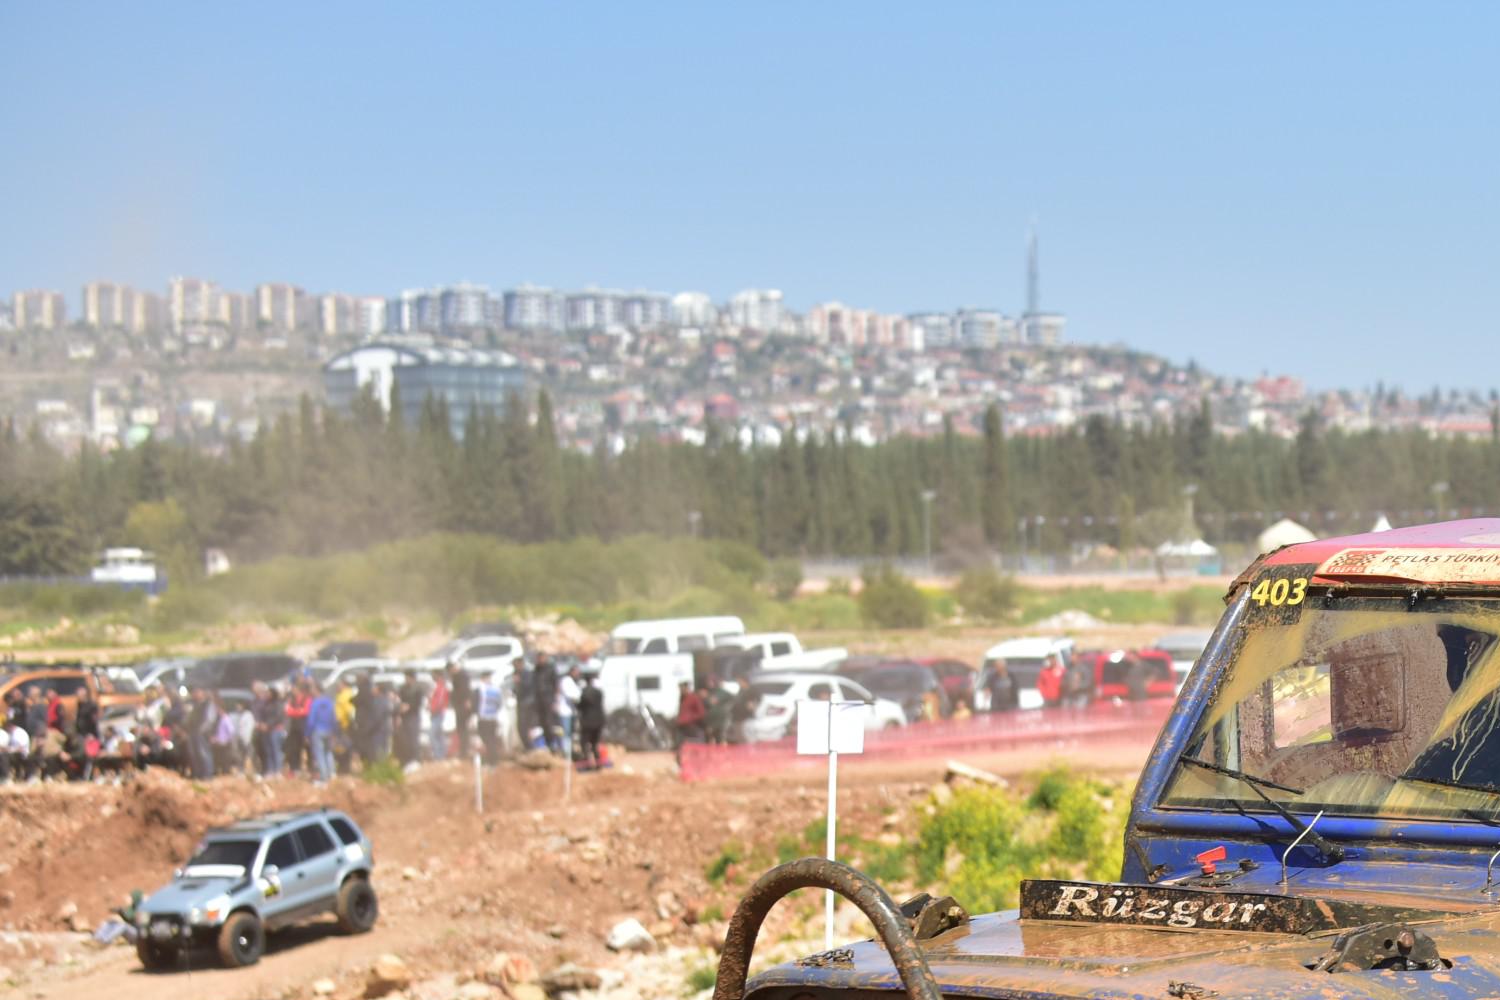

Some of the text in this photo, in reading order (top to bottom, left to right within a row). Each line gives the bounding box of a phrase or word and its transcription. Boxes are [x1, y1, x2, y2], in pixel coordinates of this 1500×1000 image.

[1382, 555, 1441, 563] PETLAS
[1252, 577, 1308, 607] 403
[1046, 884, 1267, 929] Rüzgar
